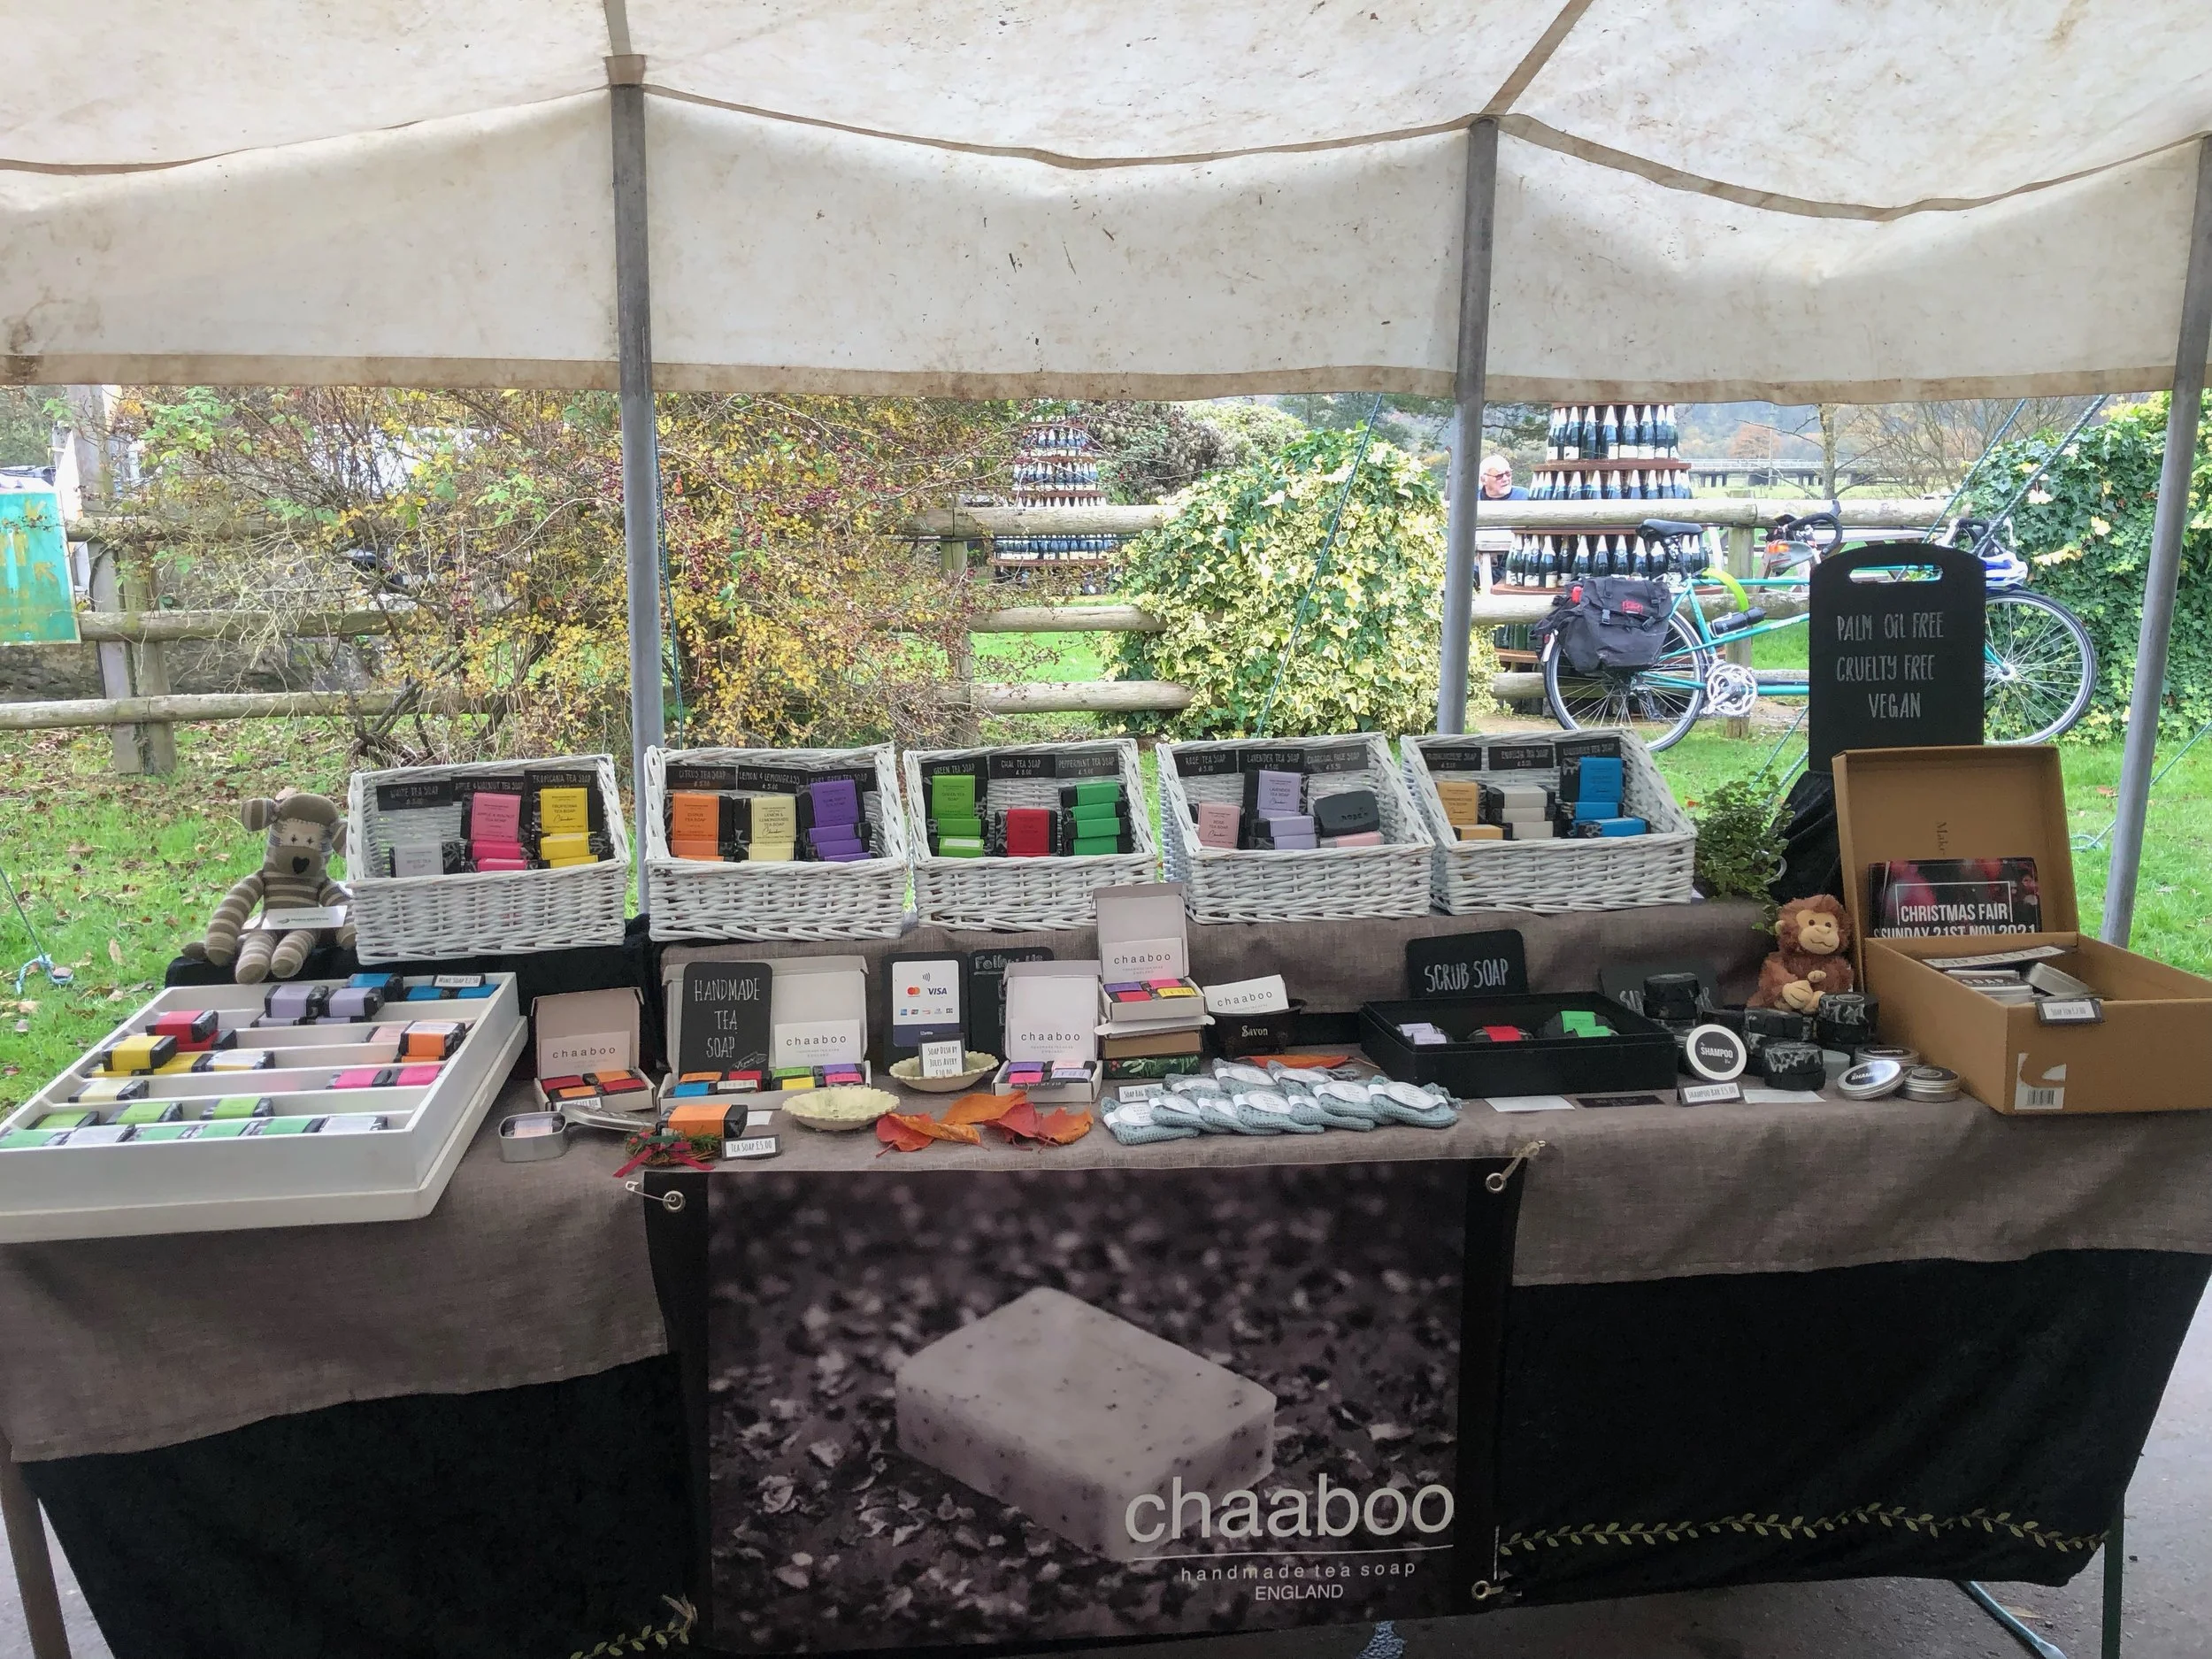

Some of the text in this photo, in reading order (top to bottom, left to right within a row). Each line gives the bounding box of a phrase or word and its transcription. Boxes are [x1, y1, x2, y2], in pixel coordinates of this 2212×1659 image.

[1837, 614, 1872, 641] PALM
[1913, 611, 1944, 638] FREE
[1836, 654, 1935, 681] CRUELTY FREE
[1869, 692, 1921, 718] VEGAN
[1018, 759, 1028, 768] TEA
[1092, 757, 1102, 767] TEA
[1247, 754, 1273, 764] LAVENDER
[679, 770, 699, 779] CITRUS
[933, 765, 950, 774] GREEN
[952, 764, 961, 773] TEA
[566, 773, 576, 782] TEA
[740, 771, 757, 780] LEMON
[764, 773, 800, 786] LEMONGRASS
[1901, 902, 2008, 923] CHRISTMAS FAIR
[1113, 953, 1171, 964] chaaboo
[1424, 957, 1509, 992] SCRUB SOAP
[695, 977, 761, 1002] HANDMADE
[1217, 990, 1272, 1007] chaaboo
[714, 1009, 738, 1031] TEA
[1020, 1031, 1080, 1041] chaaboo
[1241, 1025, 1269, 1038] Savon
[786, 1033, 848, 1047] chaaboo
[552, 1047, 616, 1059] chaaboo
[706, 1036, 736, 1059] SOAP
[1700, 1046, 1733, 1059] SHAMPOO
[1124, 1090, 1134, 1100] SOAP
[1687, 1088, 1710, 1098] SHAMPOO
[731, 1143, 740, 1153] TEA
[741, 1142, 754, 1152] SOAP
[1125, 1472, 1455, 1544] chaaboo
[1180, 1561, 1417, 1582] handmade tea soap
[1255, 1584, 1344, 1601] ENGLAND
